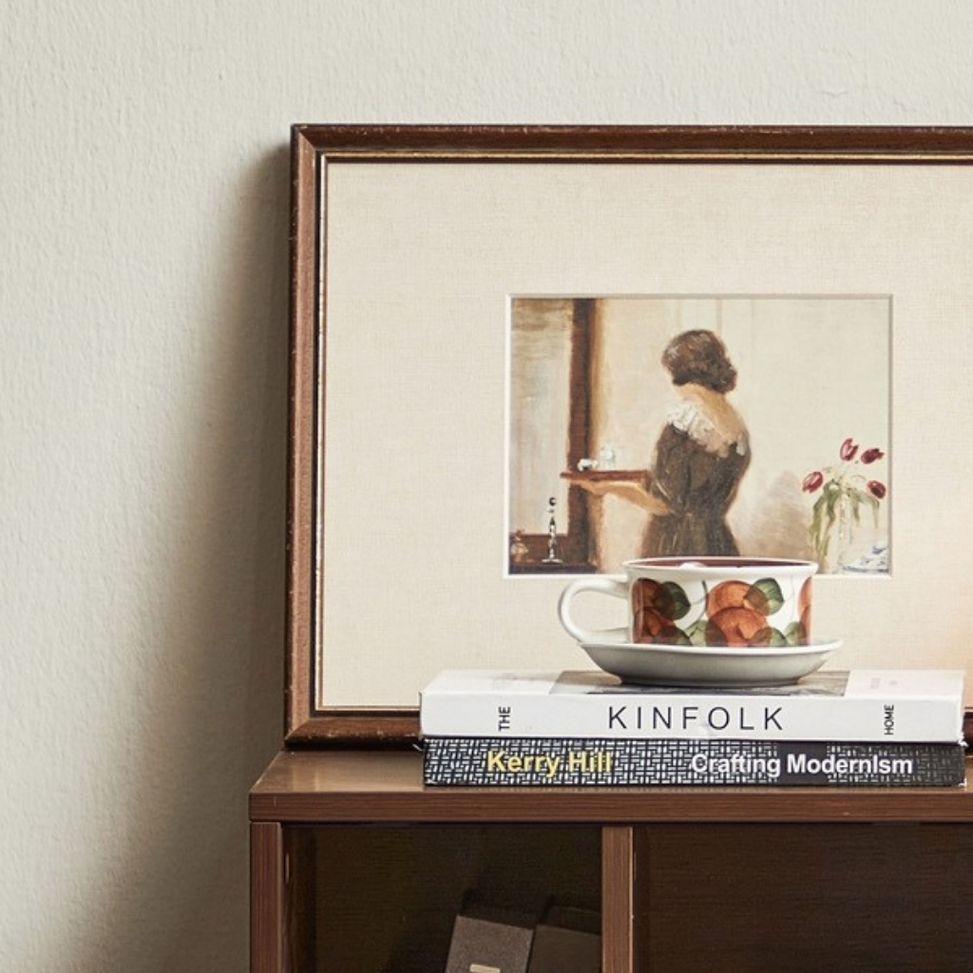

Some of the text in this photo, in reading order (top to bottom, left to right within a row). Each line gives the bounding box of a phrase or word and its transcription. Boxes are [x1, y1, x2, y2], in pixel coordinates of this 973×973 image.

[498, 706, 511, 732] THE
[608, 706, 784, 731] KINFOLK
[884, 705, 895, 736] HOME
[487, 752, 613, 778] Kerry Hill
[691, 753, 781, 778] Crafting
